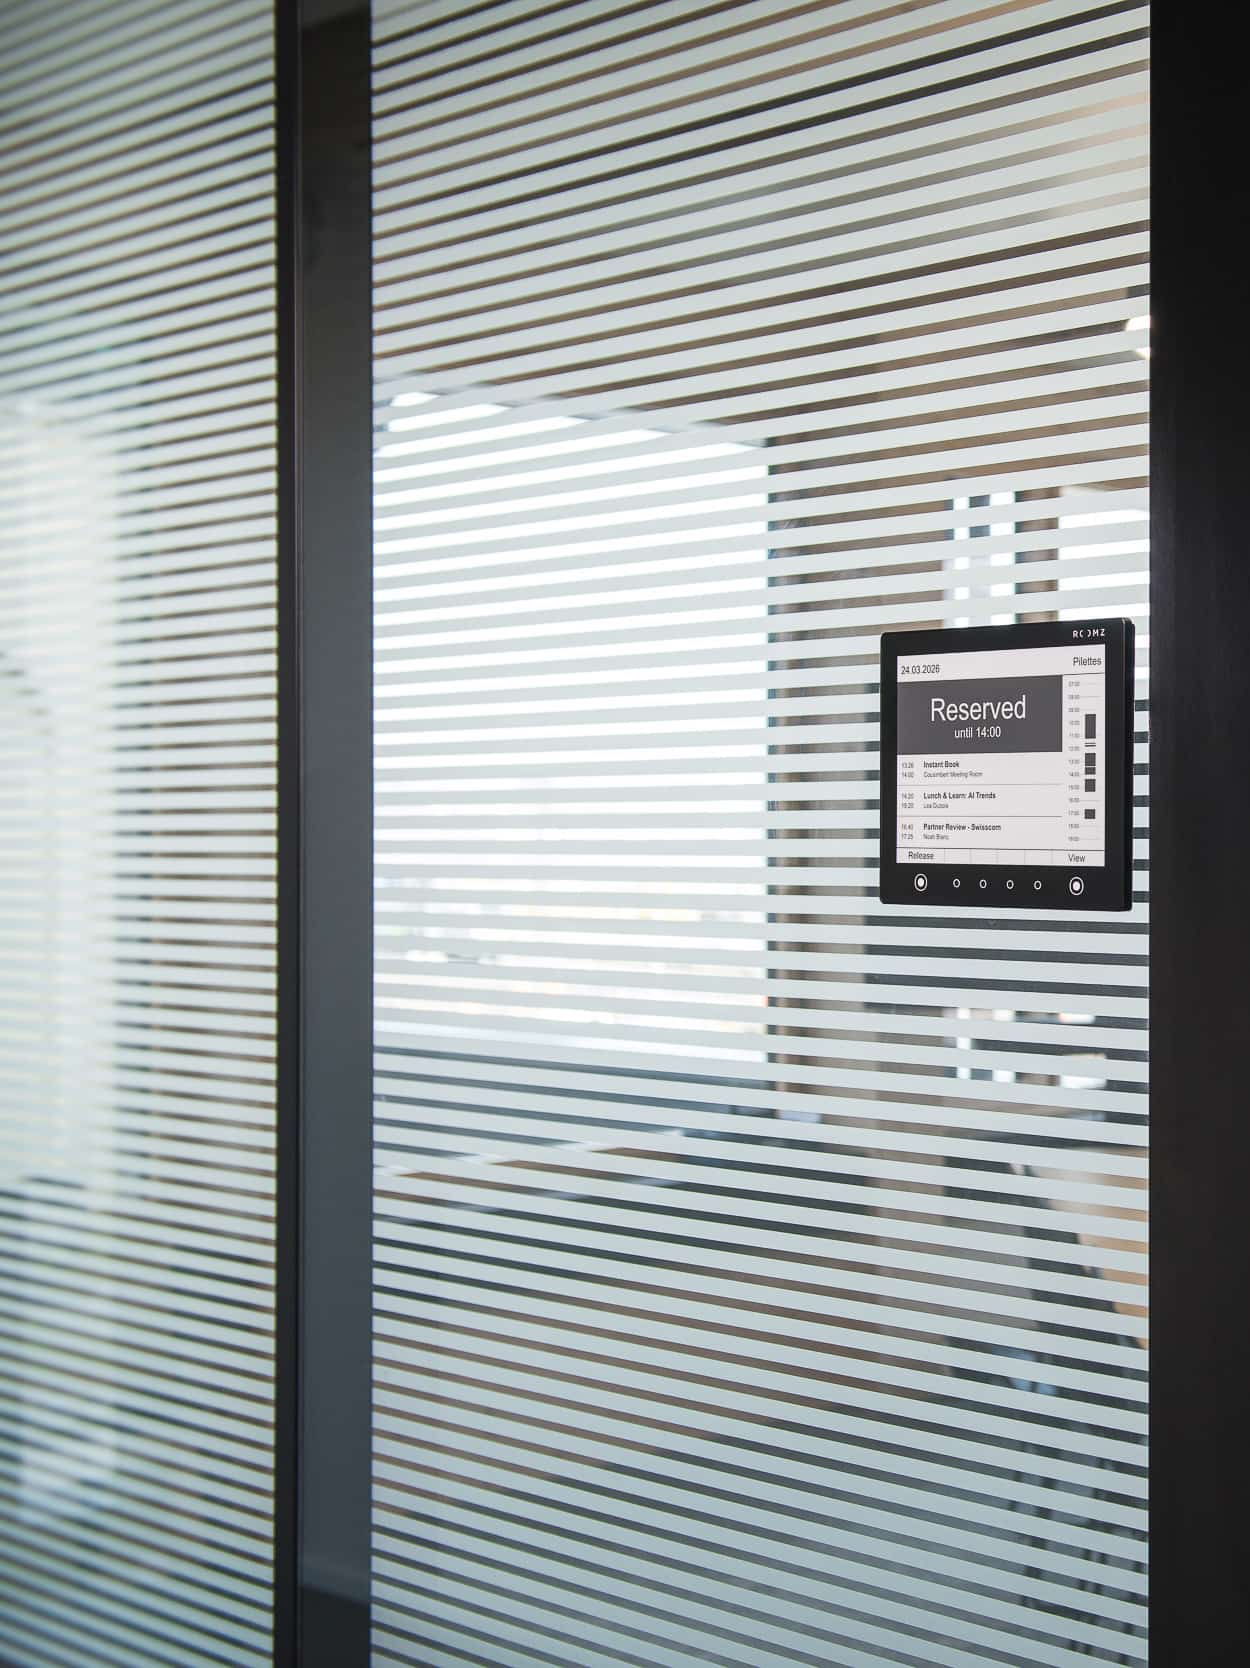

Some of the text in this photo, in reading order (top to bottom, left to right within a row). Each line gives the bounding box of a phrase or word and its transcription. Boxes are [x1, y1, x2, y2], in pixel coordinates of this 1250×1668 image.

[1072, 656, 1102, 666] Pilettes
[931, 694, 1026, 722] Reserved
[954, 726, 1001, 739] until 14:00
[923, 760, 960, 768] Instant Book
[923, 792, 942, 800] Lunch
[942, 792, 948, 800] &
[976, 791, 996, 799] Trends
[923, 823, 945, 831] Partner
[945, 823, 966, 831] Review
[970, 823, 1002, 831] Swisscom
[908, 851, 934, 860] Release
[1068, 853, 1086, 863] View
